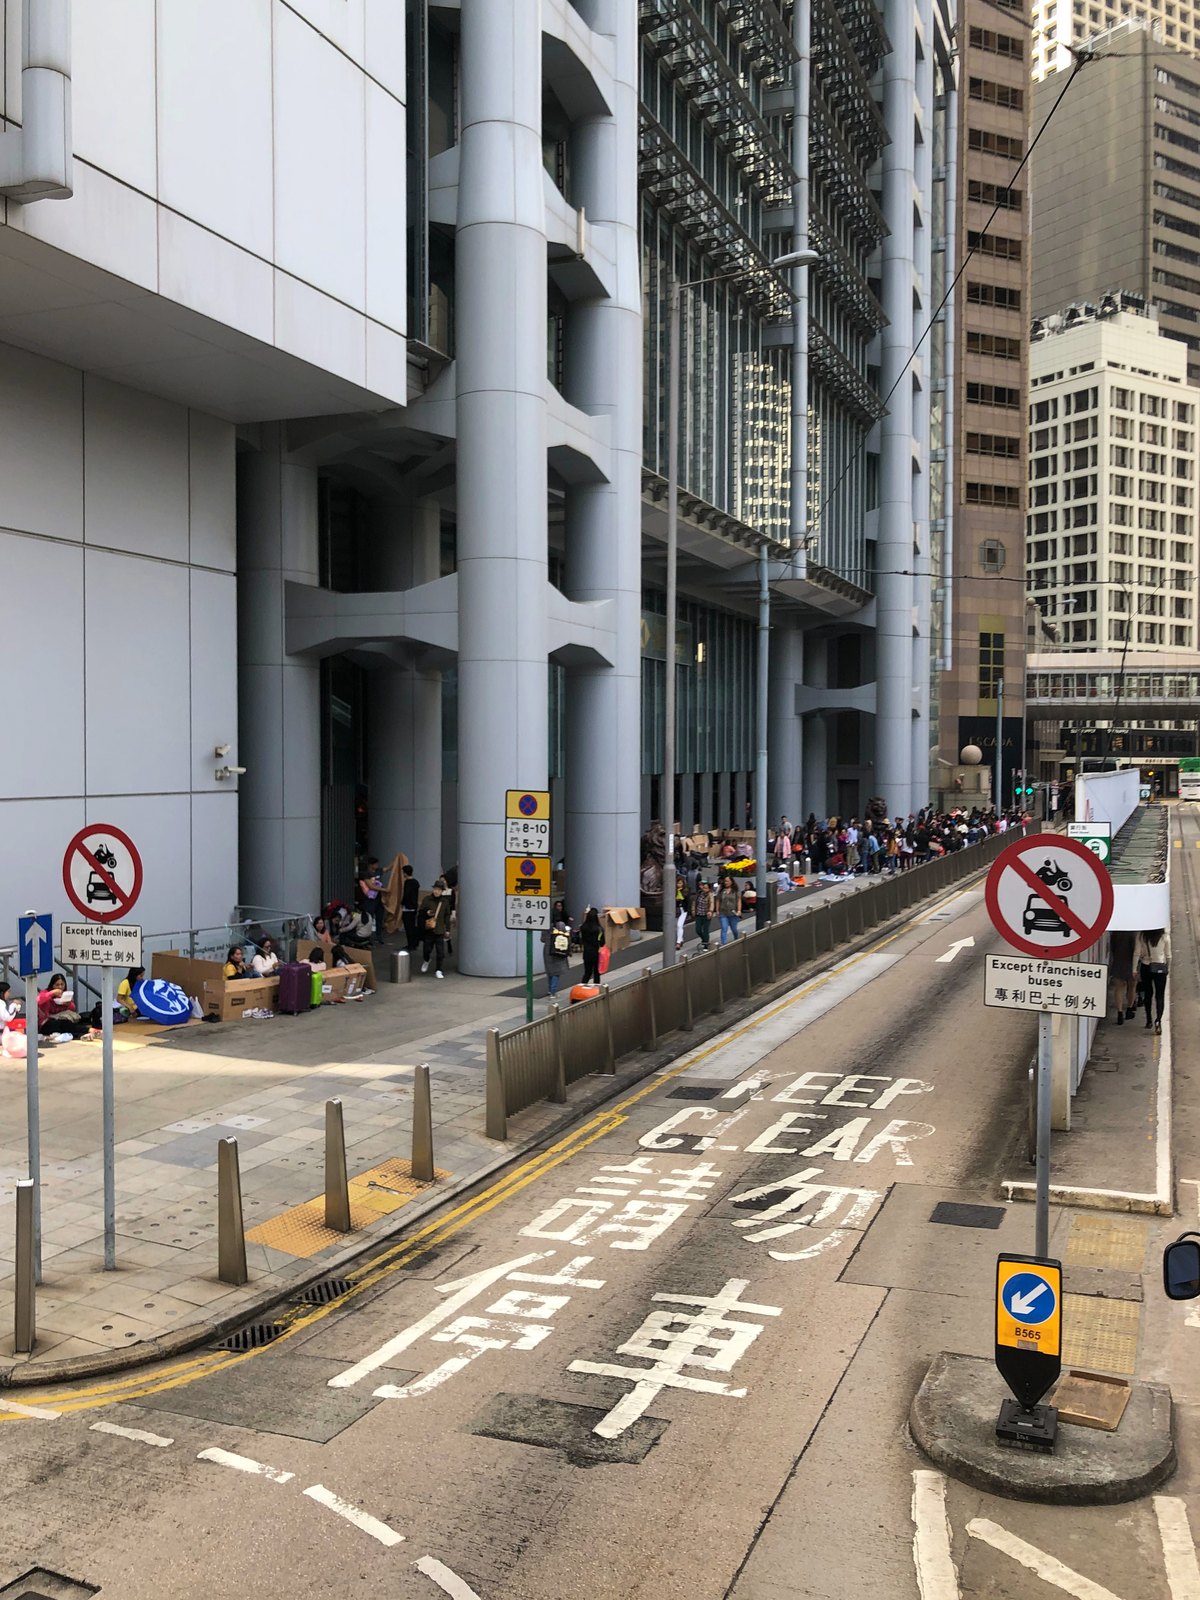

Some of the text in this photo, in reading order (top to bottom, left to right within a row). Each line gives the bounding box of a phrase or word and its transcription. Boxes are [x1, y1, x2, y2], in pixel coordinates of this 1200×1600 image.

[522, 823, 547, 834] 8-10
[525, 900, 548, 910] 8-10
[65, 926, 137, 938] Except franchised
[90, 937, 113, 946] buses
[68, 949, 135, 963] 專利巴士例外
[992, 959, 1101, 979] Except franchised
[1028, 975, 1063, 988] buses
[994, 987, 1096, 1011] 專利巴士例外
[722, 1069, 934, 1110] KEEP
[638, 1107, 935, 1166] CLEAR
[1014, 1327, 1041, 1340] B565
